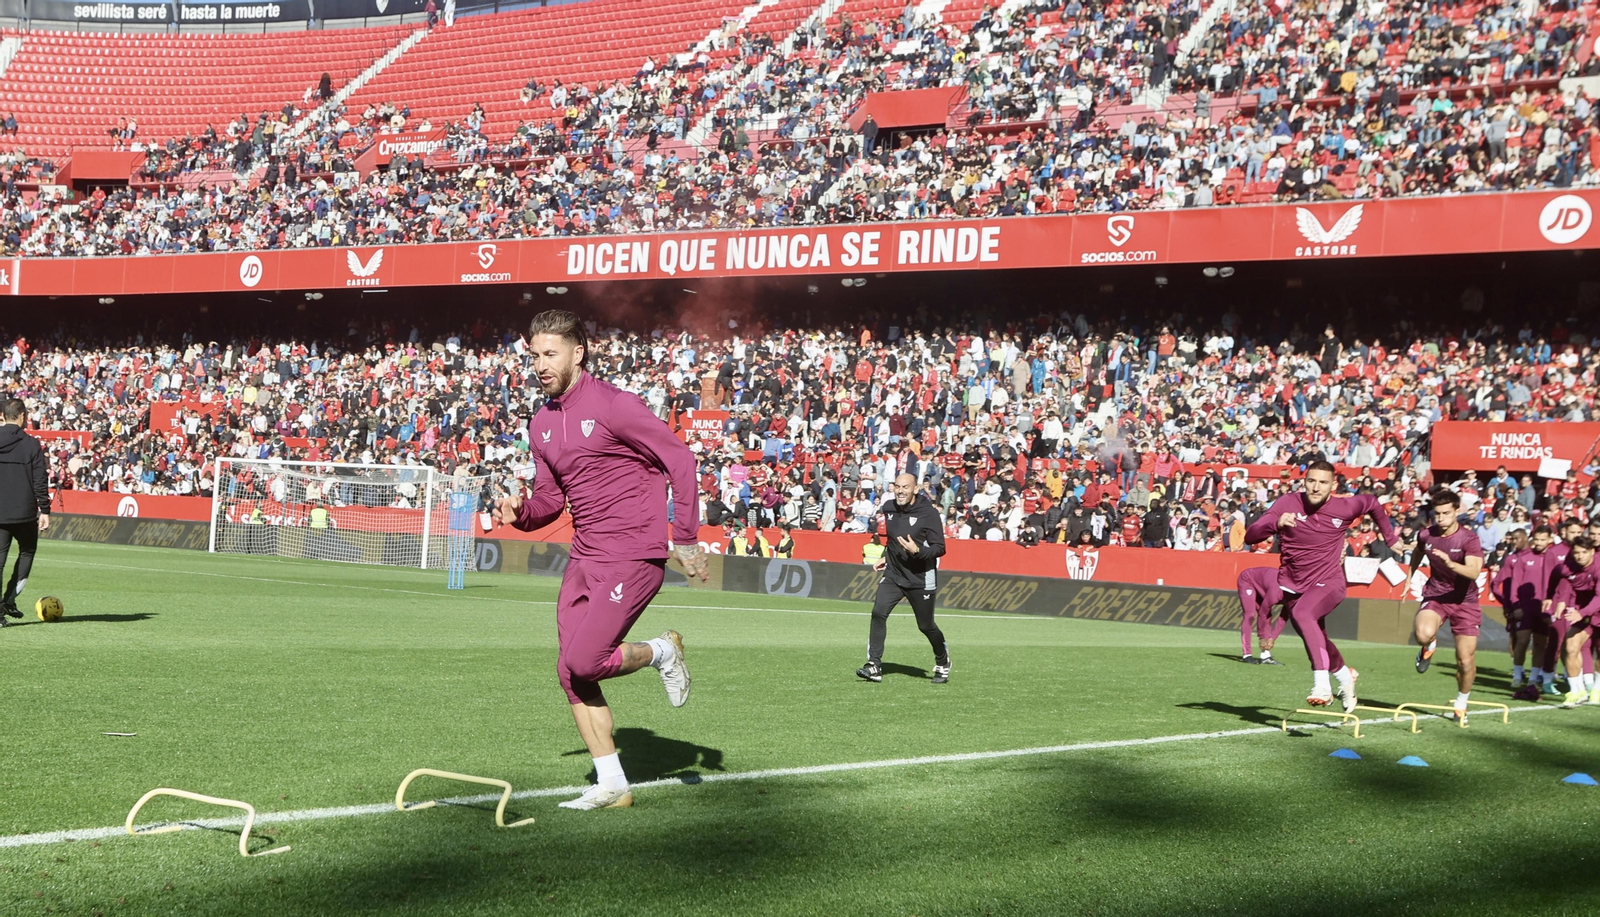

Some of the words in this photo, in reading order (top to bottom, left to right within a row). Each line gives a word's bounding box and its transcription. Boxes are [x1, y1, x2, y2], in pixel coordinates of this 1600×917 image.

[74, 3, 134, 18] sevillista
[138, 3, 167, 19] seré
[181, 4, 217, 20] hasta
[220, 4, 232, 20] la
[235, 3, 280, 19] muerte
[1546, 208, 1584, 231] JD
[566, 241, 650, 275] DICEN
[659, 238, 718, 276] QUE
[725, 233, 831, 270] NUNCA
[840, 231, 881, 267] SE
[898, 226, 1001, 264] RINDE
[1295, 245, 1357, 257] CASTORE
[243, 263, 259, 278] JD
[346, 278, 380, 286] CASTORE
[692, 419, 723, 429] NUNCA
[1491, 433, 1542, 446] NUNCA
[1479, 446, 1497, 458] TE
[1500, 446, 1553, 459] RINDAS
[59, 517, 117, 541] FORWARD
[127, 521, 186, 547] FOREVER
[770, 564, 807, 593] JD
[935, 576, 1039, 611] FORWARD
[1059, 586, 1171, 623] FOREVER
[1165, 593, 1244, 629] FORWA
